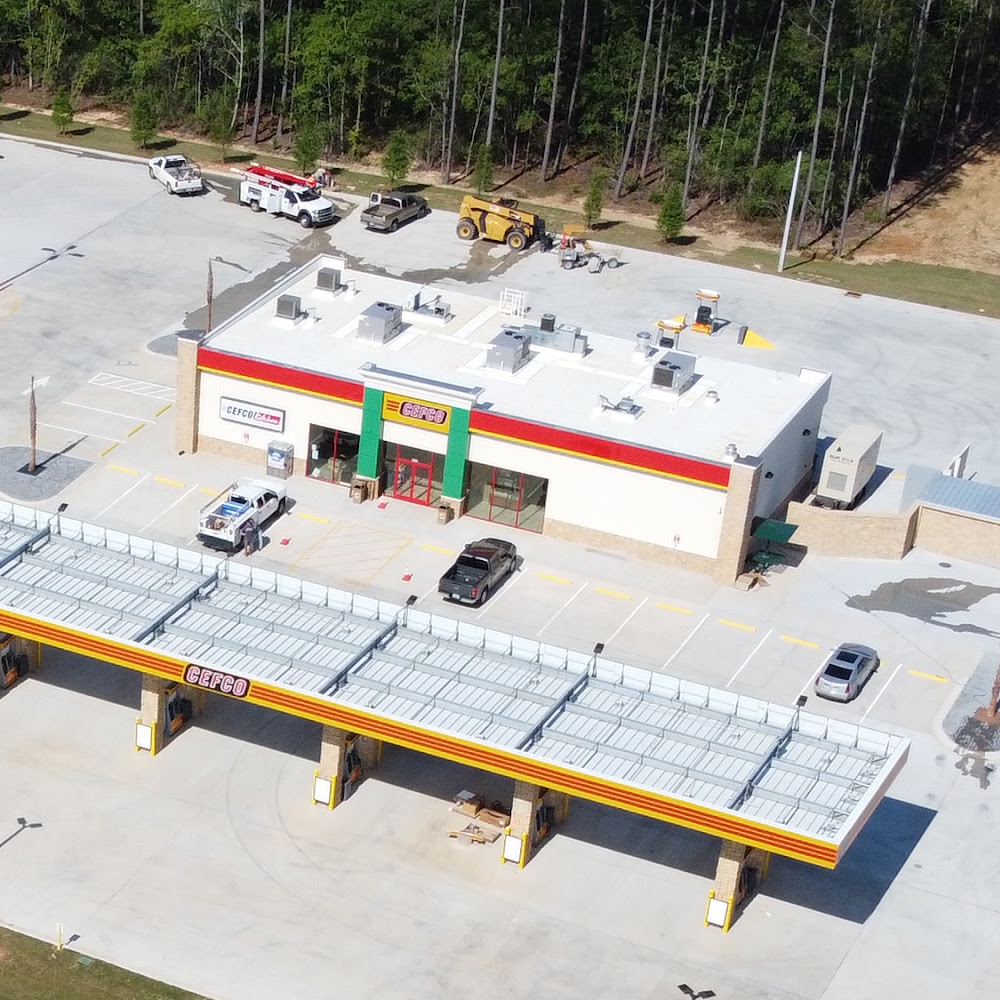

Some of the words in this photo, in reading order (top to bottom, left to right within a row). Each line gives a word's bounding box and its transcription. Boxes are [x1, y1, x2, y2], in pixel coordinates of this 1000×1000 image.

[227, 406, 253, 419] CEFCO
[402, 402, 445, 423] CEFCO
[186, 665, 248, 697] CEFCO
